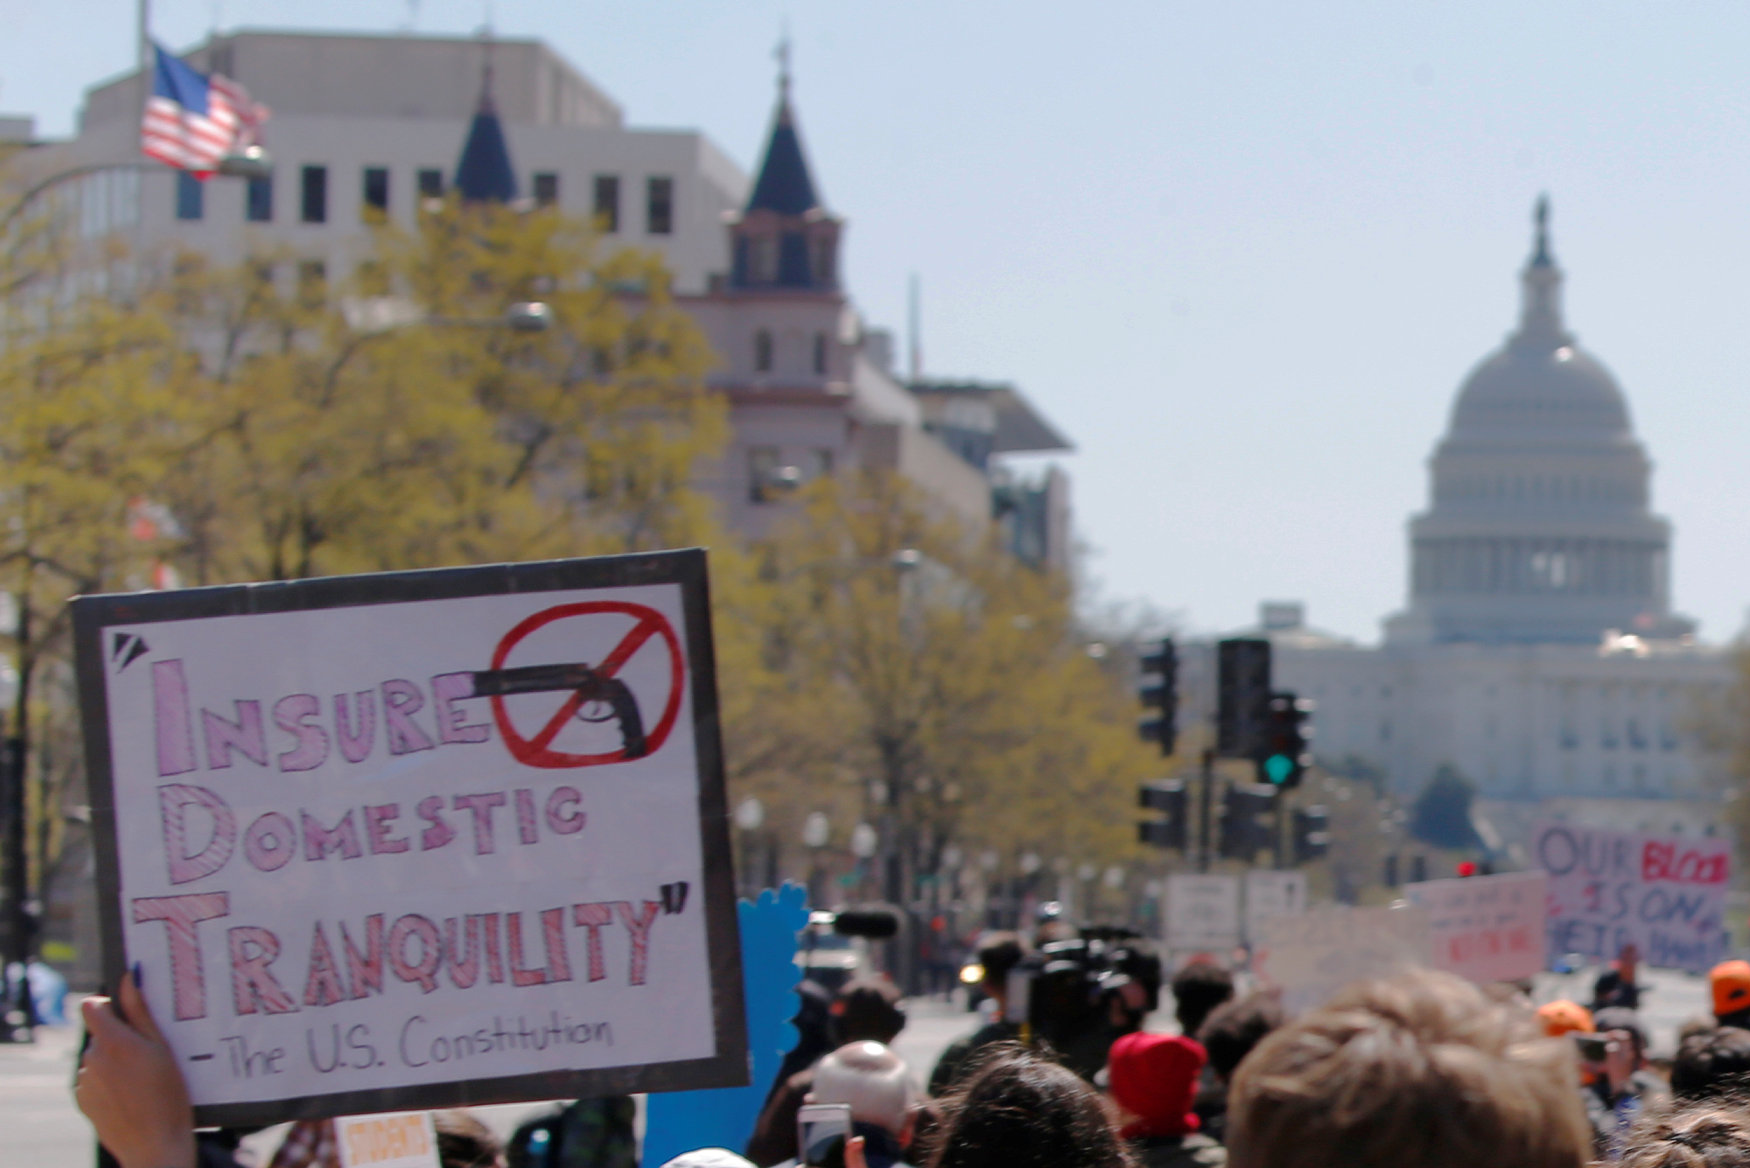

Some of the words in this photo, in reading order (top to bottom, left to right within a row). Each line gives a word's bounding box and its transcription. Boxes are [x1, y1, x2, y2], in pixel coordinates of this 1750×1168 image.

[157, 783, 587, 885] DOMESTIC
[306, 1022, 386, 1074] U.S.
[399, 1014, 616, 1068] Constitution
